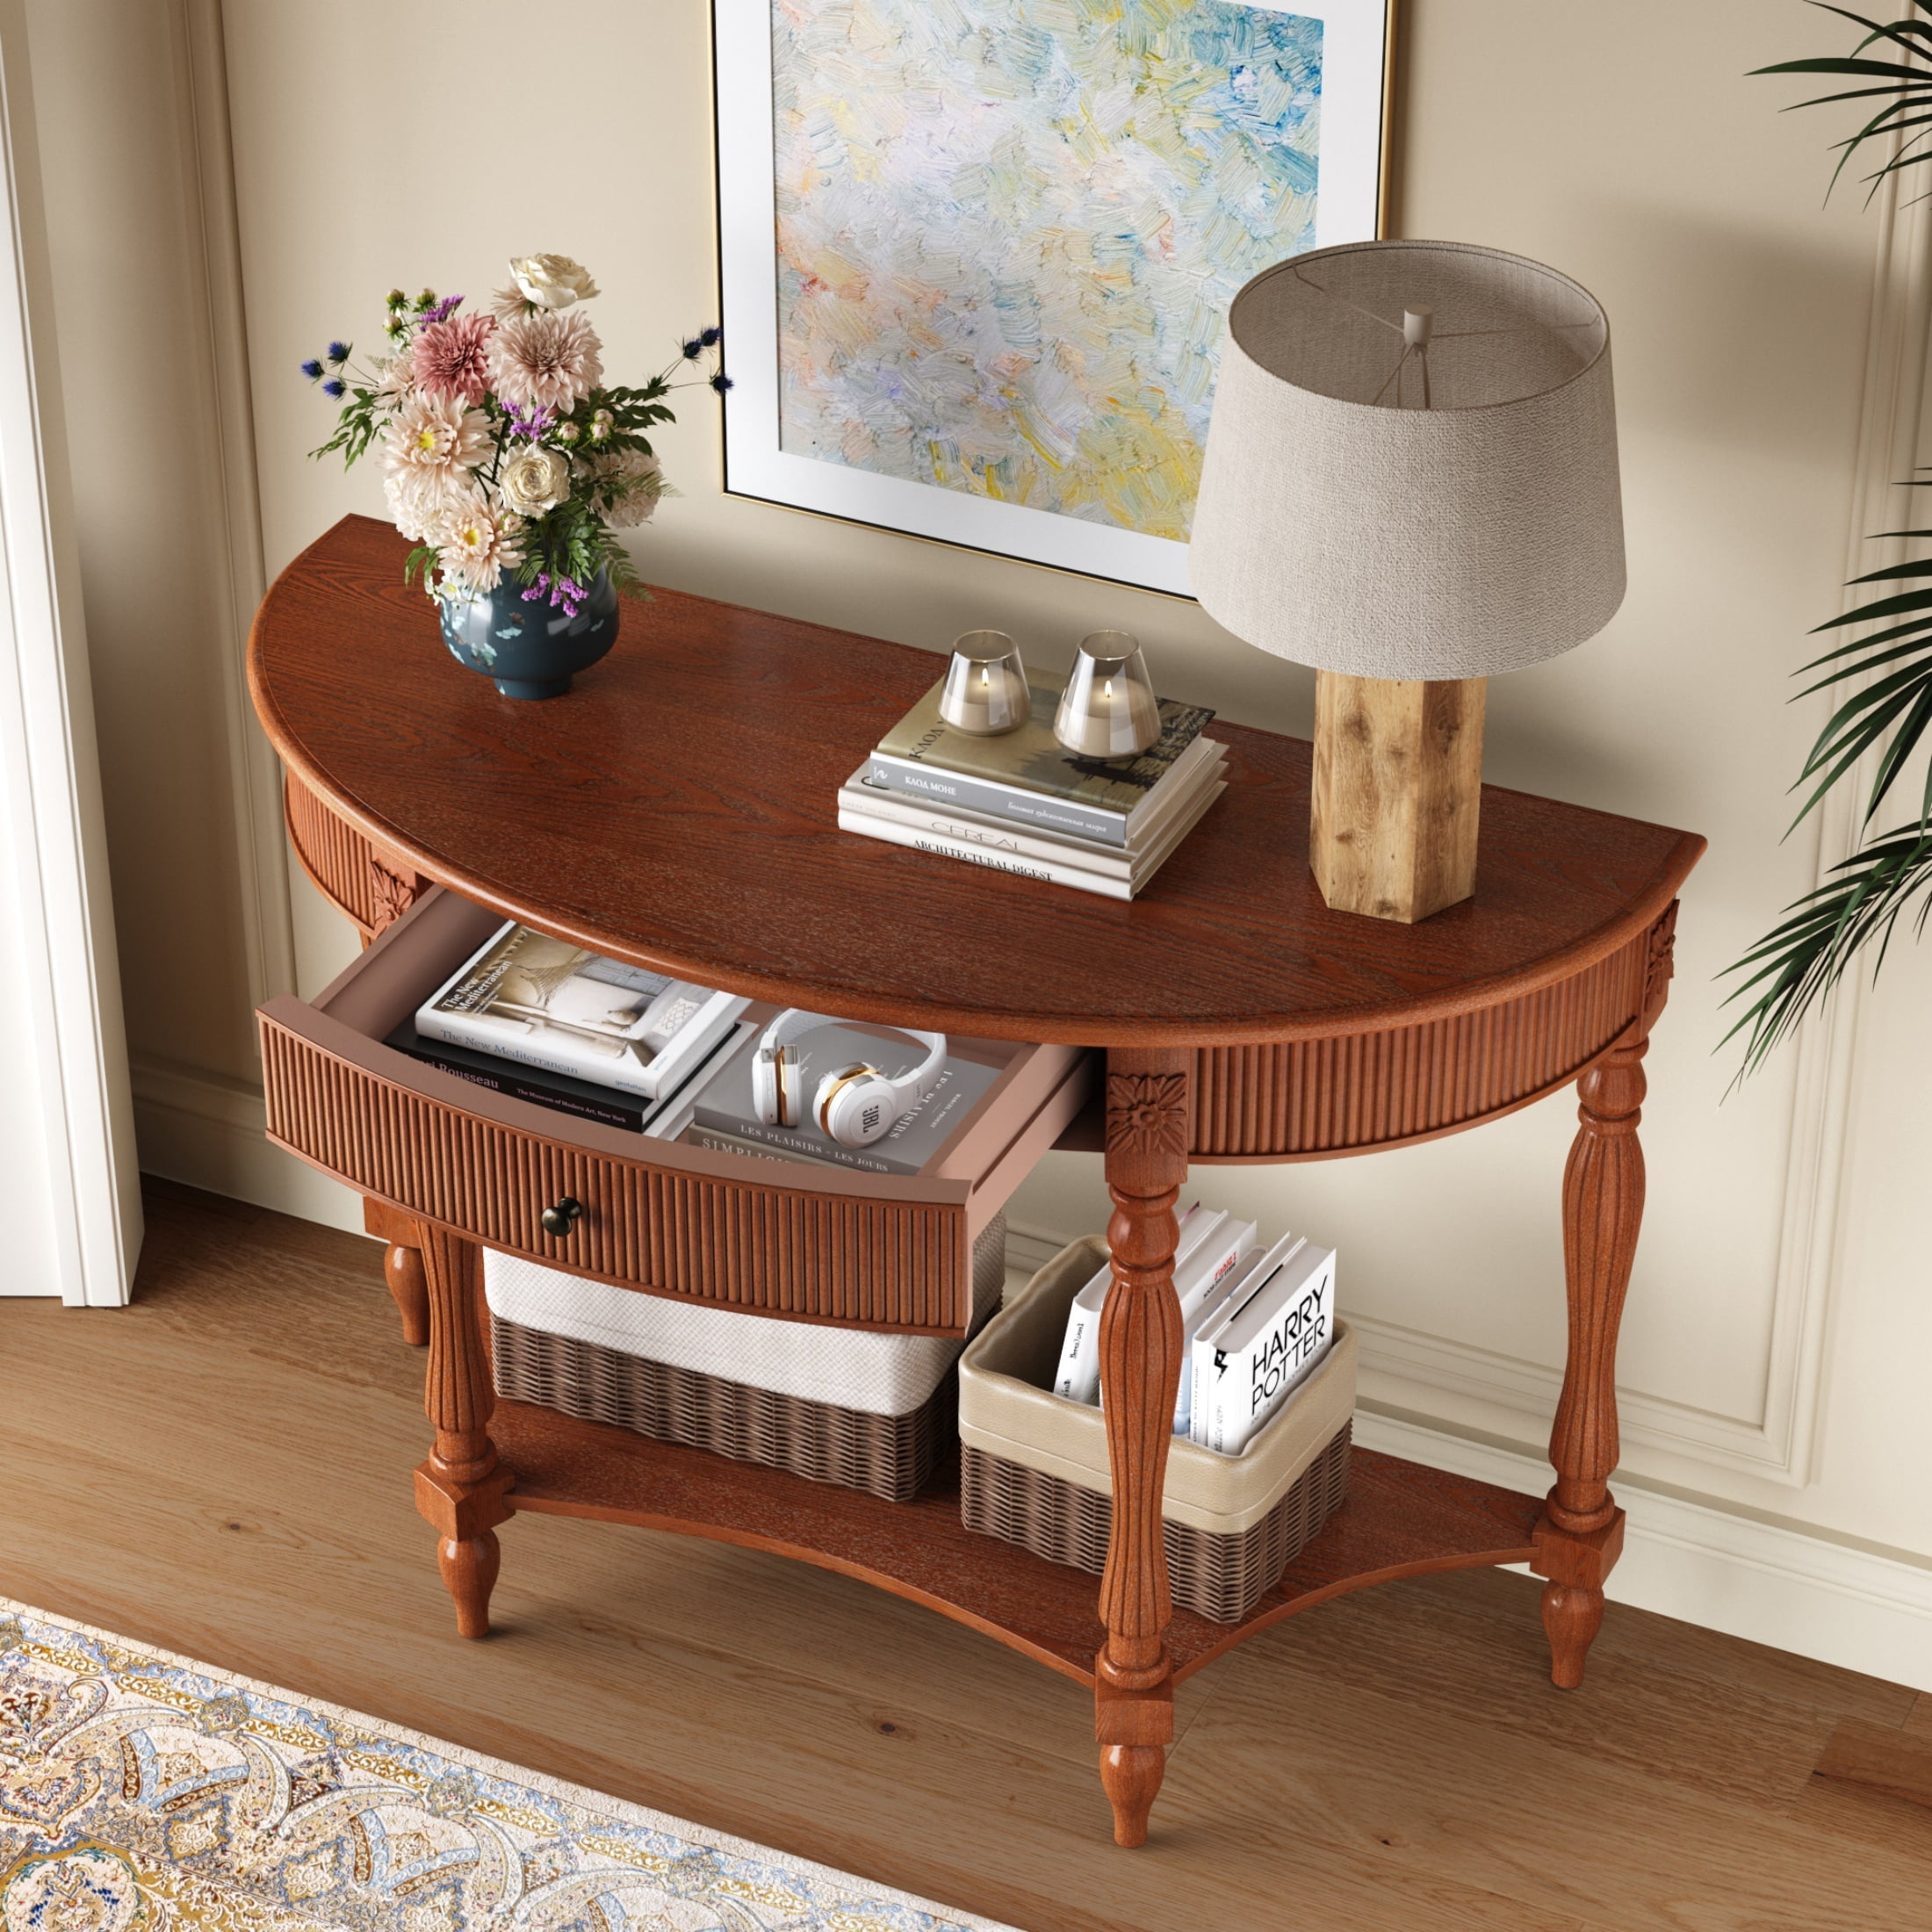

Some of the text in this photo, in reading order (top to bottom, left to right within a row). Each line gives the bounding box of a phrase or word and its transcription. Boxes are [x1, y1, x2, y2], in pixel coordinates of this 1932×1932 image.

[905, 775, 956, 796] КЛОД МОНЕ
[914, 840, 1053, 881] ARCHITECTURAL DIGEST
[441, 993, 464, 1007] The
[456, 977, 479, 994] New
[455, 961, 513, 1012] Mediterranean
[441, 1029, 578, 1075] The New Mediterranean
[439, 1063, 499, 1089] Rousseau
[530, 1092, 554, 1103] Museum
[562, 1100, 584, 1112] Modern
[612, 1114, 626, 1122] York
[862, 1105, 879, 1134] JBL
[740, 1124, 888, 1171] LES PLAISIRS LES JOURS
[1252, 1274, 1328, 1386] HARRY
[1252, 1315, 1325, 1416] POTTER
